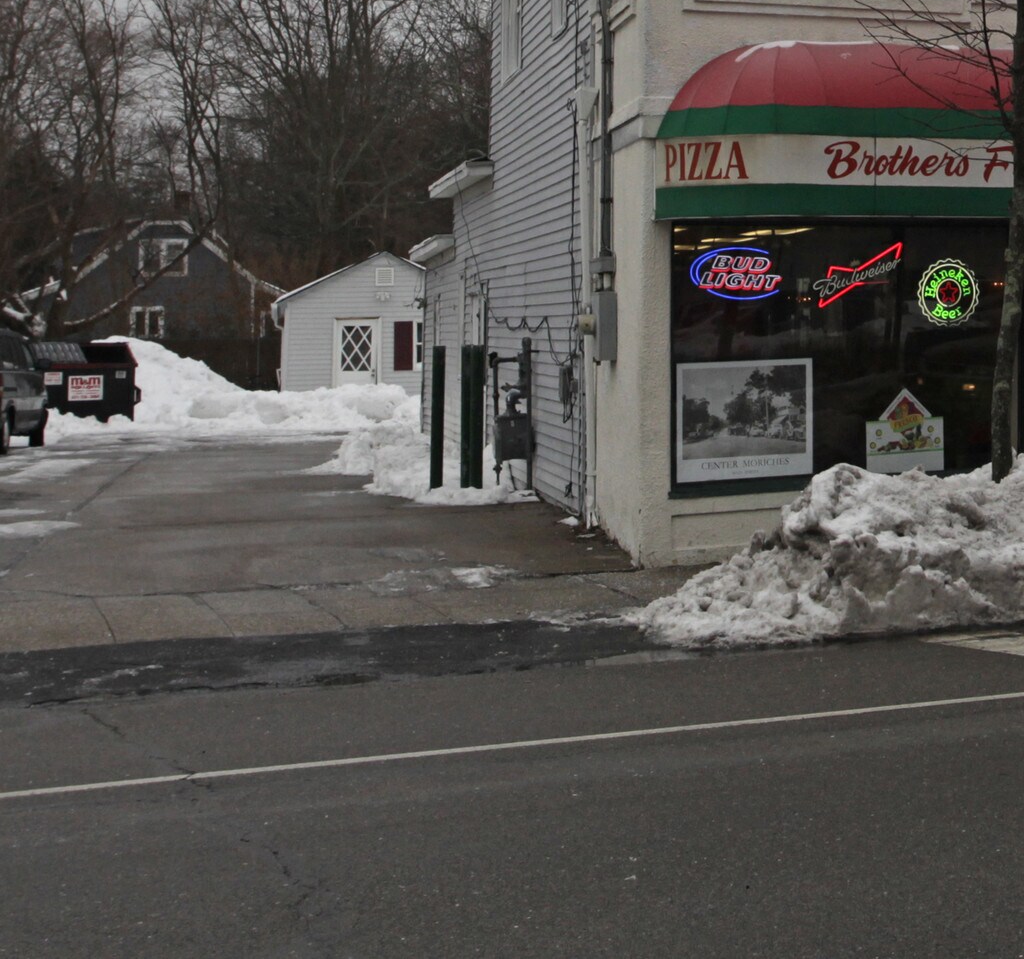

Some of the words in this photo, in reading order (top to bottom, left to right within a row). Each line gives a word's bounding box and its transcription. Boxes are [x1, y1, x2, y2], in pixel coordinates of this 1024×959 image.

[664, 141, 749, 182] PIZZA
[824, 141, 969, 179] Brothers
[711, 255, 772, 274] BUD
[699, 272, 782, 290] LIGHT
[813, 258, 901, 298] Budweiser
[925, 268, 971, 298] Heineken
[932, 303, 962, 319] Beer
[701, 460, 738, 471] CENTER
[743, 457, 790, 468] MORICHES
